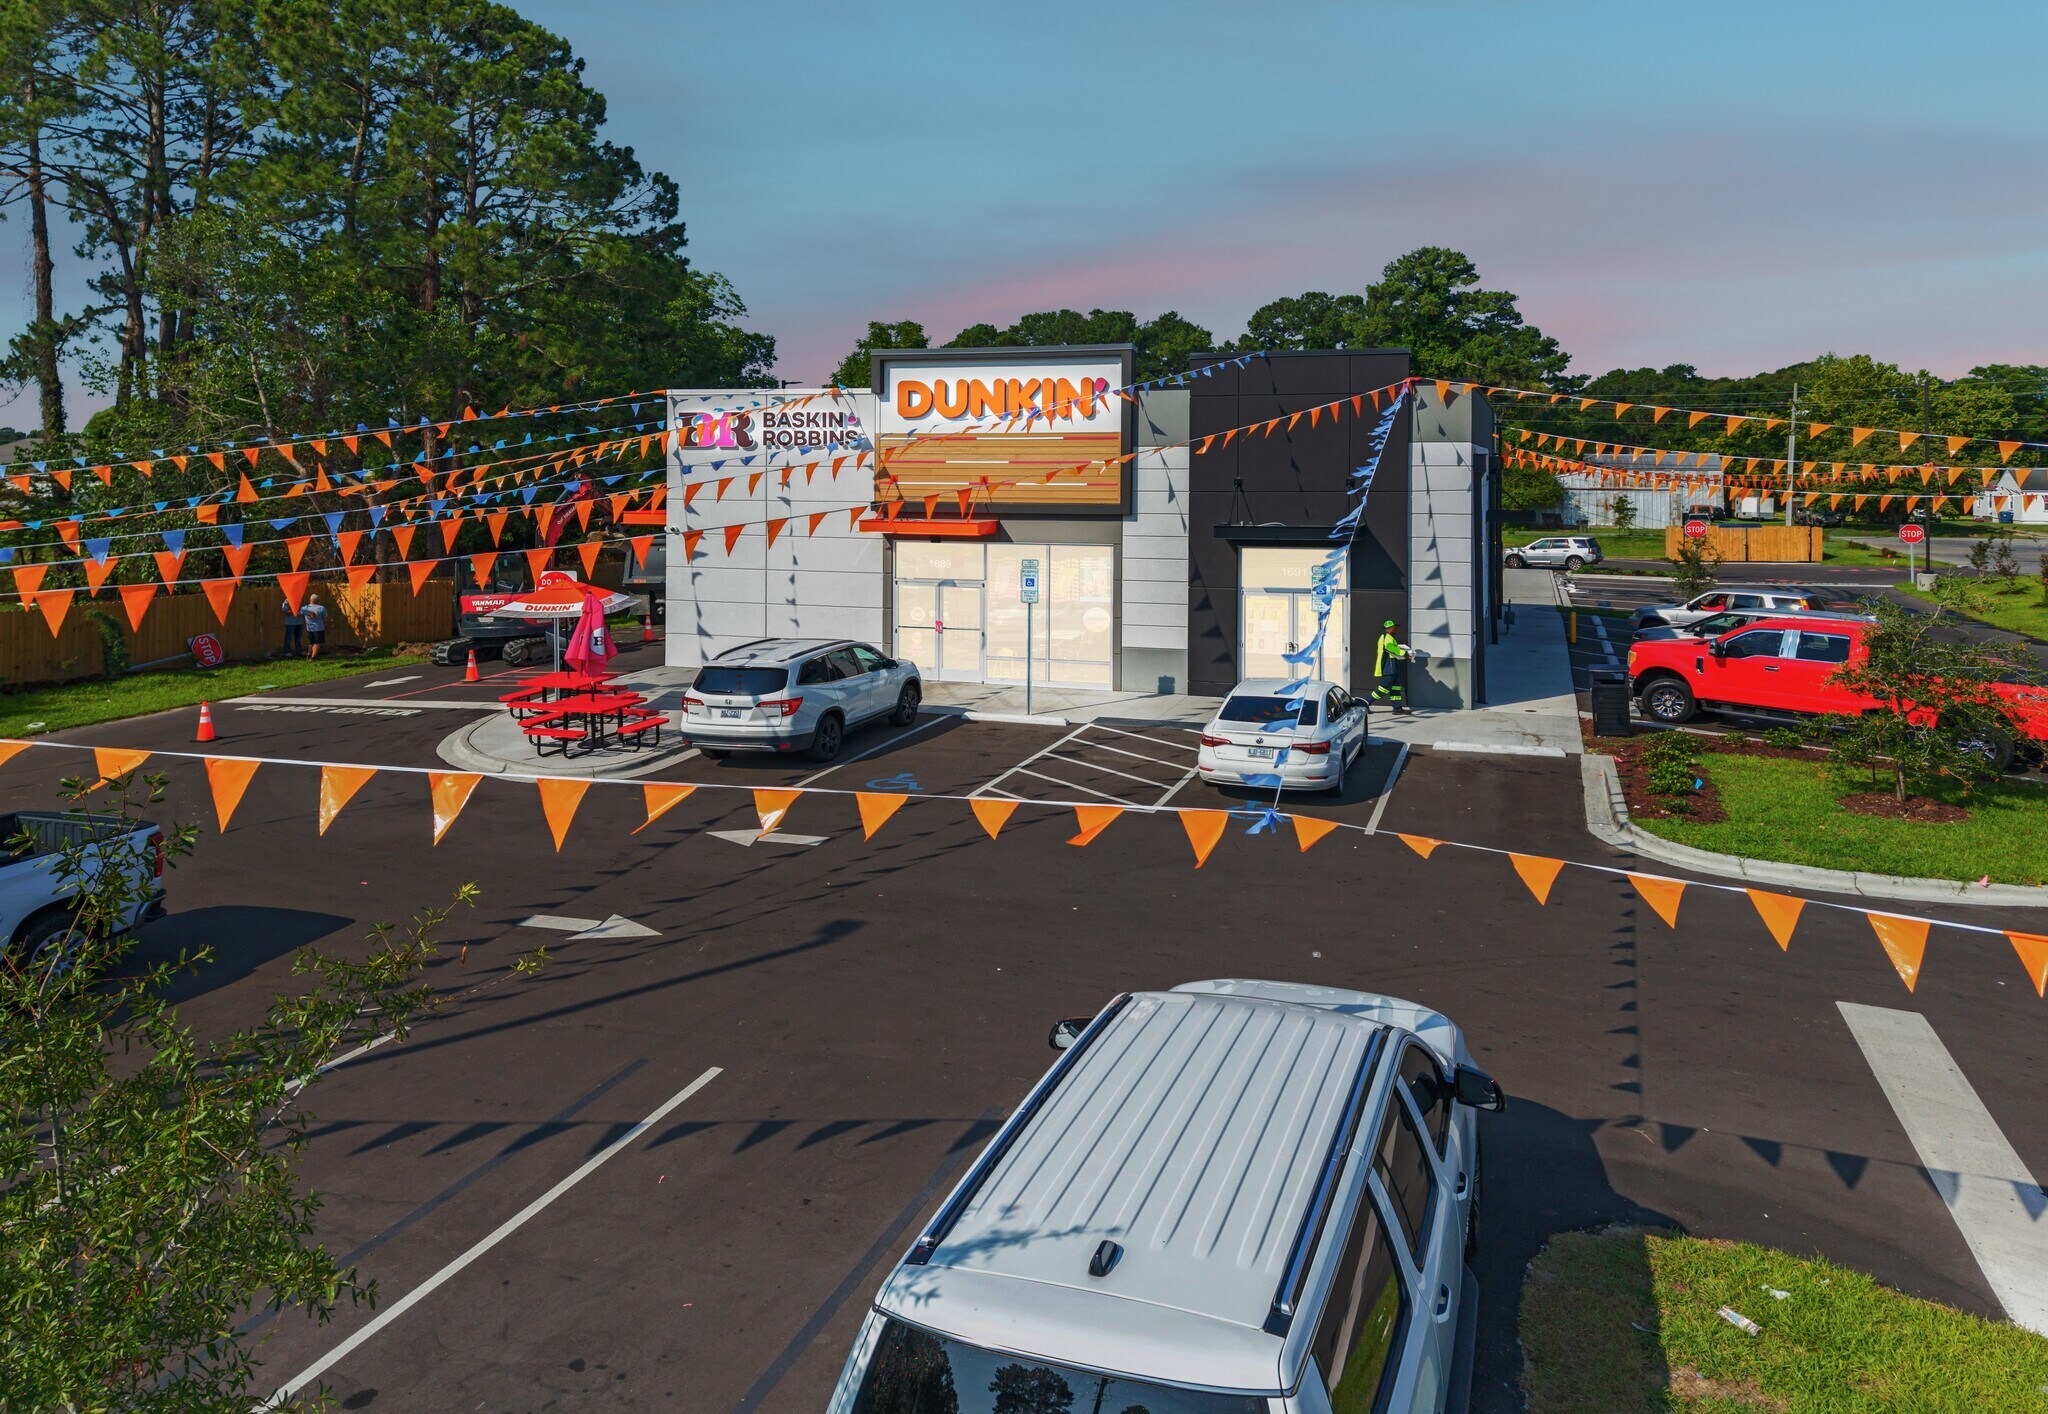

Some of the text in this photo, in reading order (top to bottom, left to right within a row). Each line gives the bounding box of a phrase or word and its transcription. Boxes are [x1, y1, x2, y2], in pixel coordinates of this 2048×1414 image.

[897, 377, 1107, 418] DUNKIN'
[763, 412, 844, 428] BASKIN
[763, 430, 858, 447] ROBBINS
[1686, 525, 1705, 534] STOP
[1901, 530, 1923, 538] STOP
[524, 604, 575, 612] DUNKIN'
[198, 637, 216, 663] STOP
